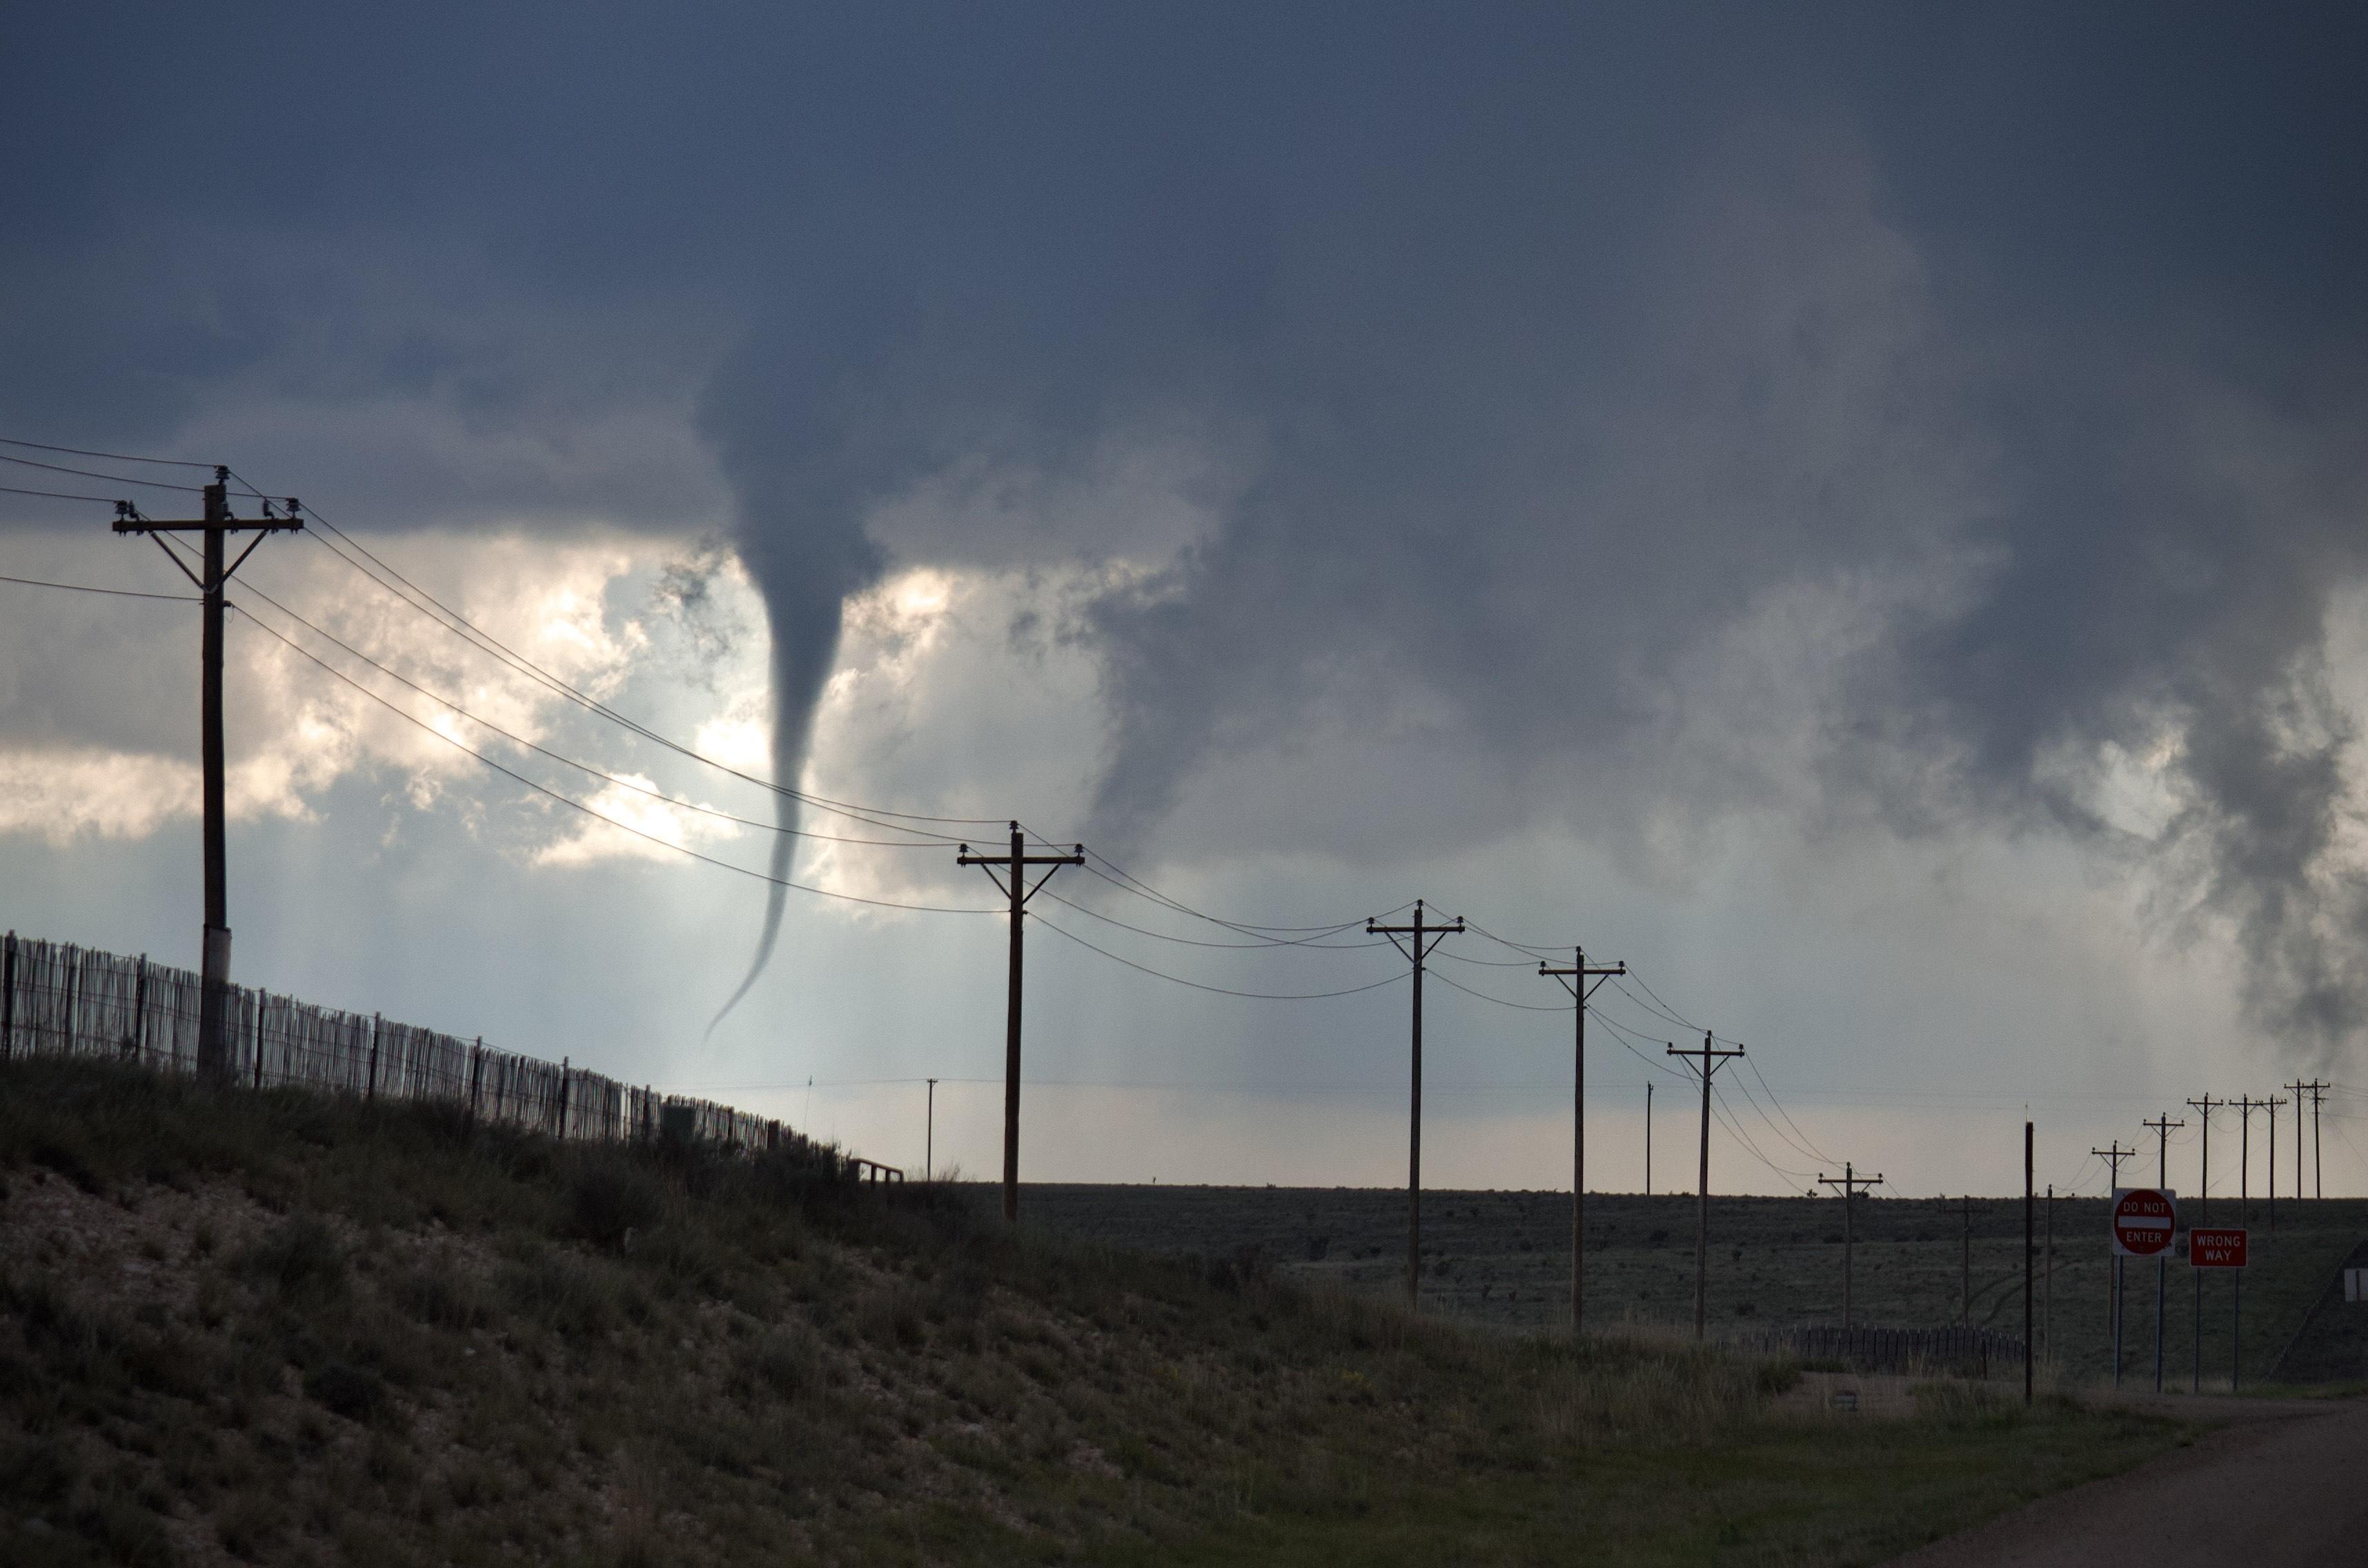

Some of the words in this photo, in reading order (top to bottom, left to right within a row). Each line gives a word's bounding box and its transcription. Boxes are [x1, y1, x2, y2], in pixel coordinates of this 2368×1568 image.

[2123, 1202, 2138, 1213] DO
[2144, 1202, 2165, 1213] NOT
[2126, 1231, 2162, 1242] ENTER
[2197, 1235, 2240, 1247] WRONG
[2205, 1249, 2231, 1262] WAY
